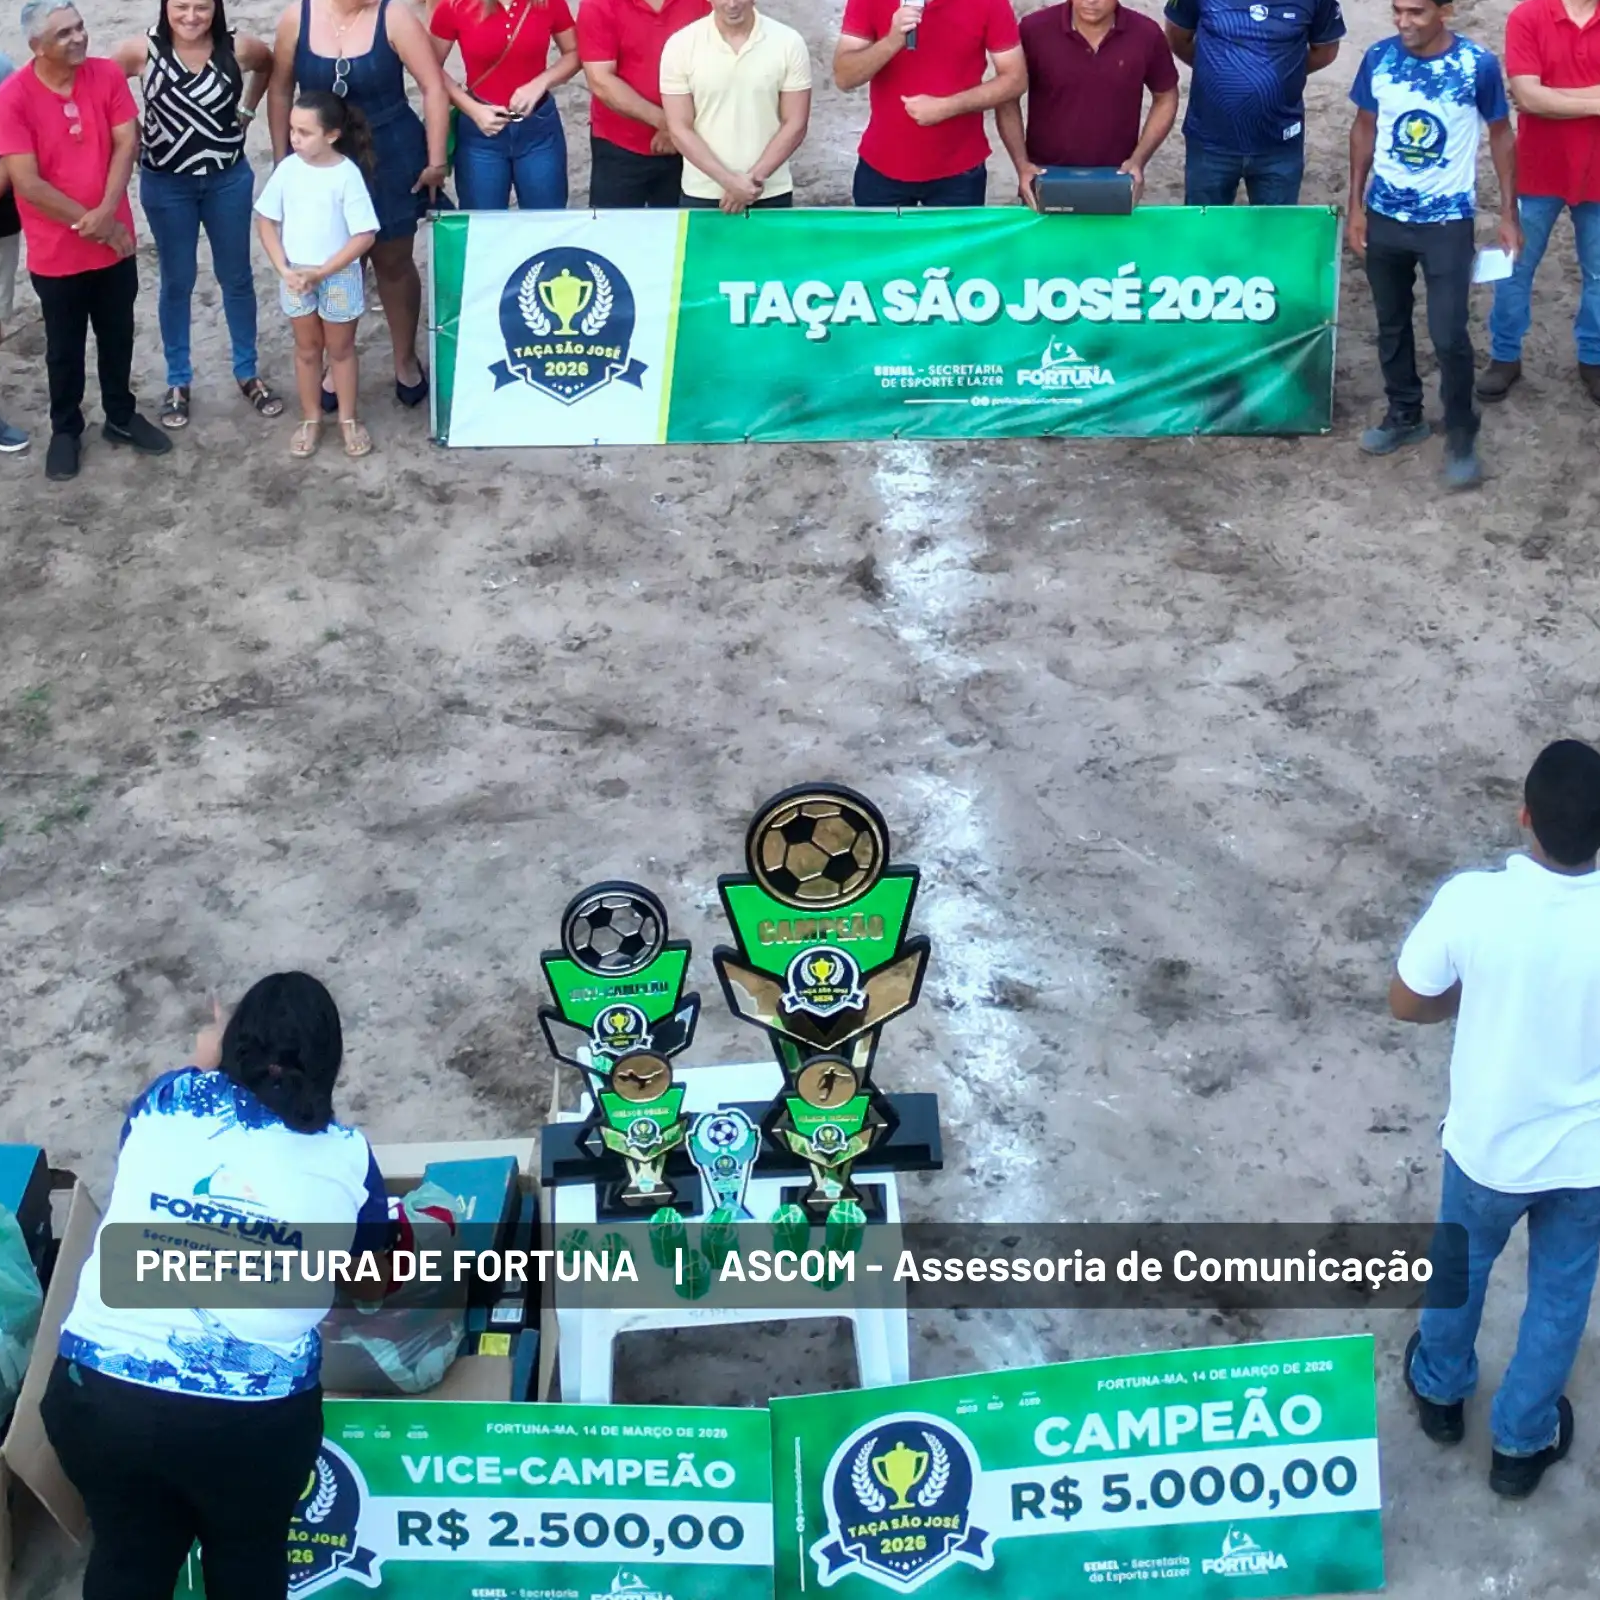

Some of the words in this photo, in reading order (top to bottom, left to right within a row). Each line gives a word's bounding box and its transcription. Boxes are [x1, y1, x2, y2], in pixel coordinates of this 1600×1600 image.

[719, 280, 878, 340] TAÇA
[882, 266, 1001, 324] SÃO
[1006, 261, 1143, 323] JOSÉ
[1148, 275, 1277, 323] 2026
[513, 346, 553, 360] TAÇA
[556, 341, 585, 357] SÃO
[587, 345, 621, 360] JOSÉ
[544, 361, 589, 377] 2026
[928, 364, 1004, 376] SECRETARIA
[1017, 367, 1116, 387] FORTUNA
[881, 377, 897, 388] DE
[900, 376, 953, 388] ESPORTE
[957, 376, 964, 387] E
[967, 375, 1003, 387] LAZER
[757, 912, 884, 946] CAMPEÃO
[150, 1192, 303, 1250] FORTUNA
[1192, 1372, 1206, 1382] 14
[1209, 1369, 1227, 1380] DE
[1230, 1365, 1280, 1379] MARÇO
[1283, 1363, 1300, 1374] DE
[1034, 1386, 1322, 1457] CAMPEÃO
[583, 1425, 597, 1436] 14
[601, 1425, 618, 1436] DE
[622, 1426, 672, 1439] MARÇO
[677, 1426, 694, 1438] DE
[401, 1452, 736, 1489] VICE-CAMPEÃO
[1011, 1475, 1083, 1523] R$
[1101, 1454, 1358, 1513] 5.000,00
[397, 1508, 470, 1551] R$
[487, 1512, 745, 1557] 2.500,00
[847, 1521, 889, 1538] TAÇA
[891, 1514, 921, 1530] SÃO
[924, 1514, 960, 1529] JOSÉ
[287, 1528, 309, 1542] ÃO
[311, 1532, 347, 1547] JOSÉ
[880, 1535, 927, 1554] 2026
[1131, 1554, 1190, 1569] Secretaria
[1202, 1551, 1288, 1574] FORTUNA
[1106, 1569, 1148, 1583] Esporte
